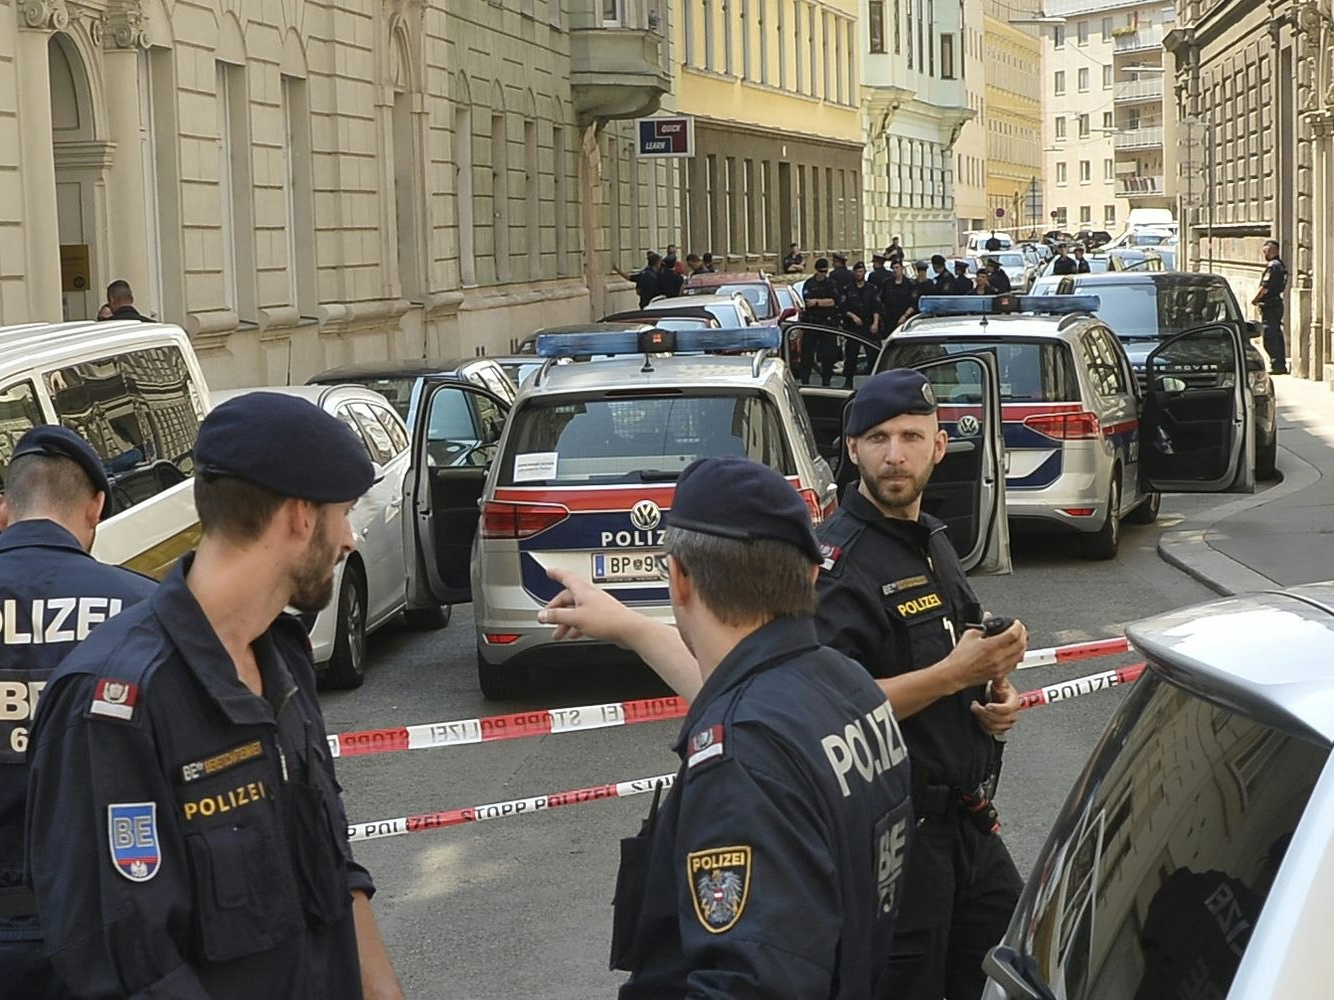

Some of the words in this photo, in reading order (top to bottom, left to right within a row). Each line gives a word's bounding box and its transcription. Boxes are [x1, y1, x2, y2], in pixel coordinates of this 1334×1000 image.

[601, 530, 667, 547] POLIZ
[897, 593, 942, 616] POLIZEI
[1047, 673, 1125, 703] POLIZEI
[10, 727, 29, 752] 6
[183, 781, 265, 819] POLIZEI
[113, 815, 155, 848] BE
[693, 852, 745, 872] POLIZEI
